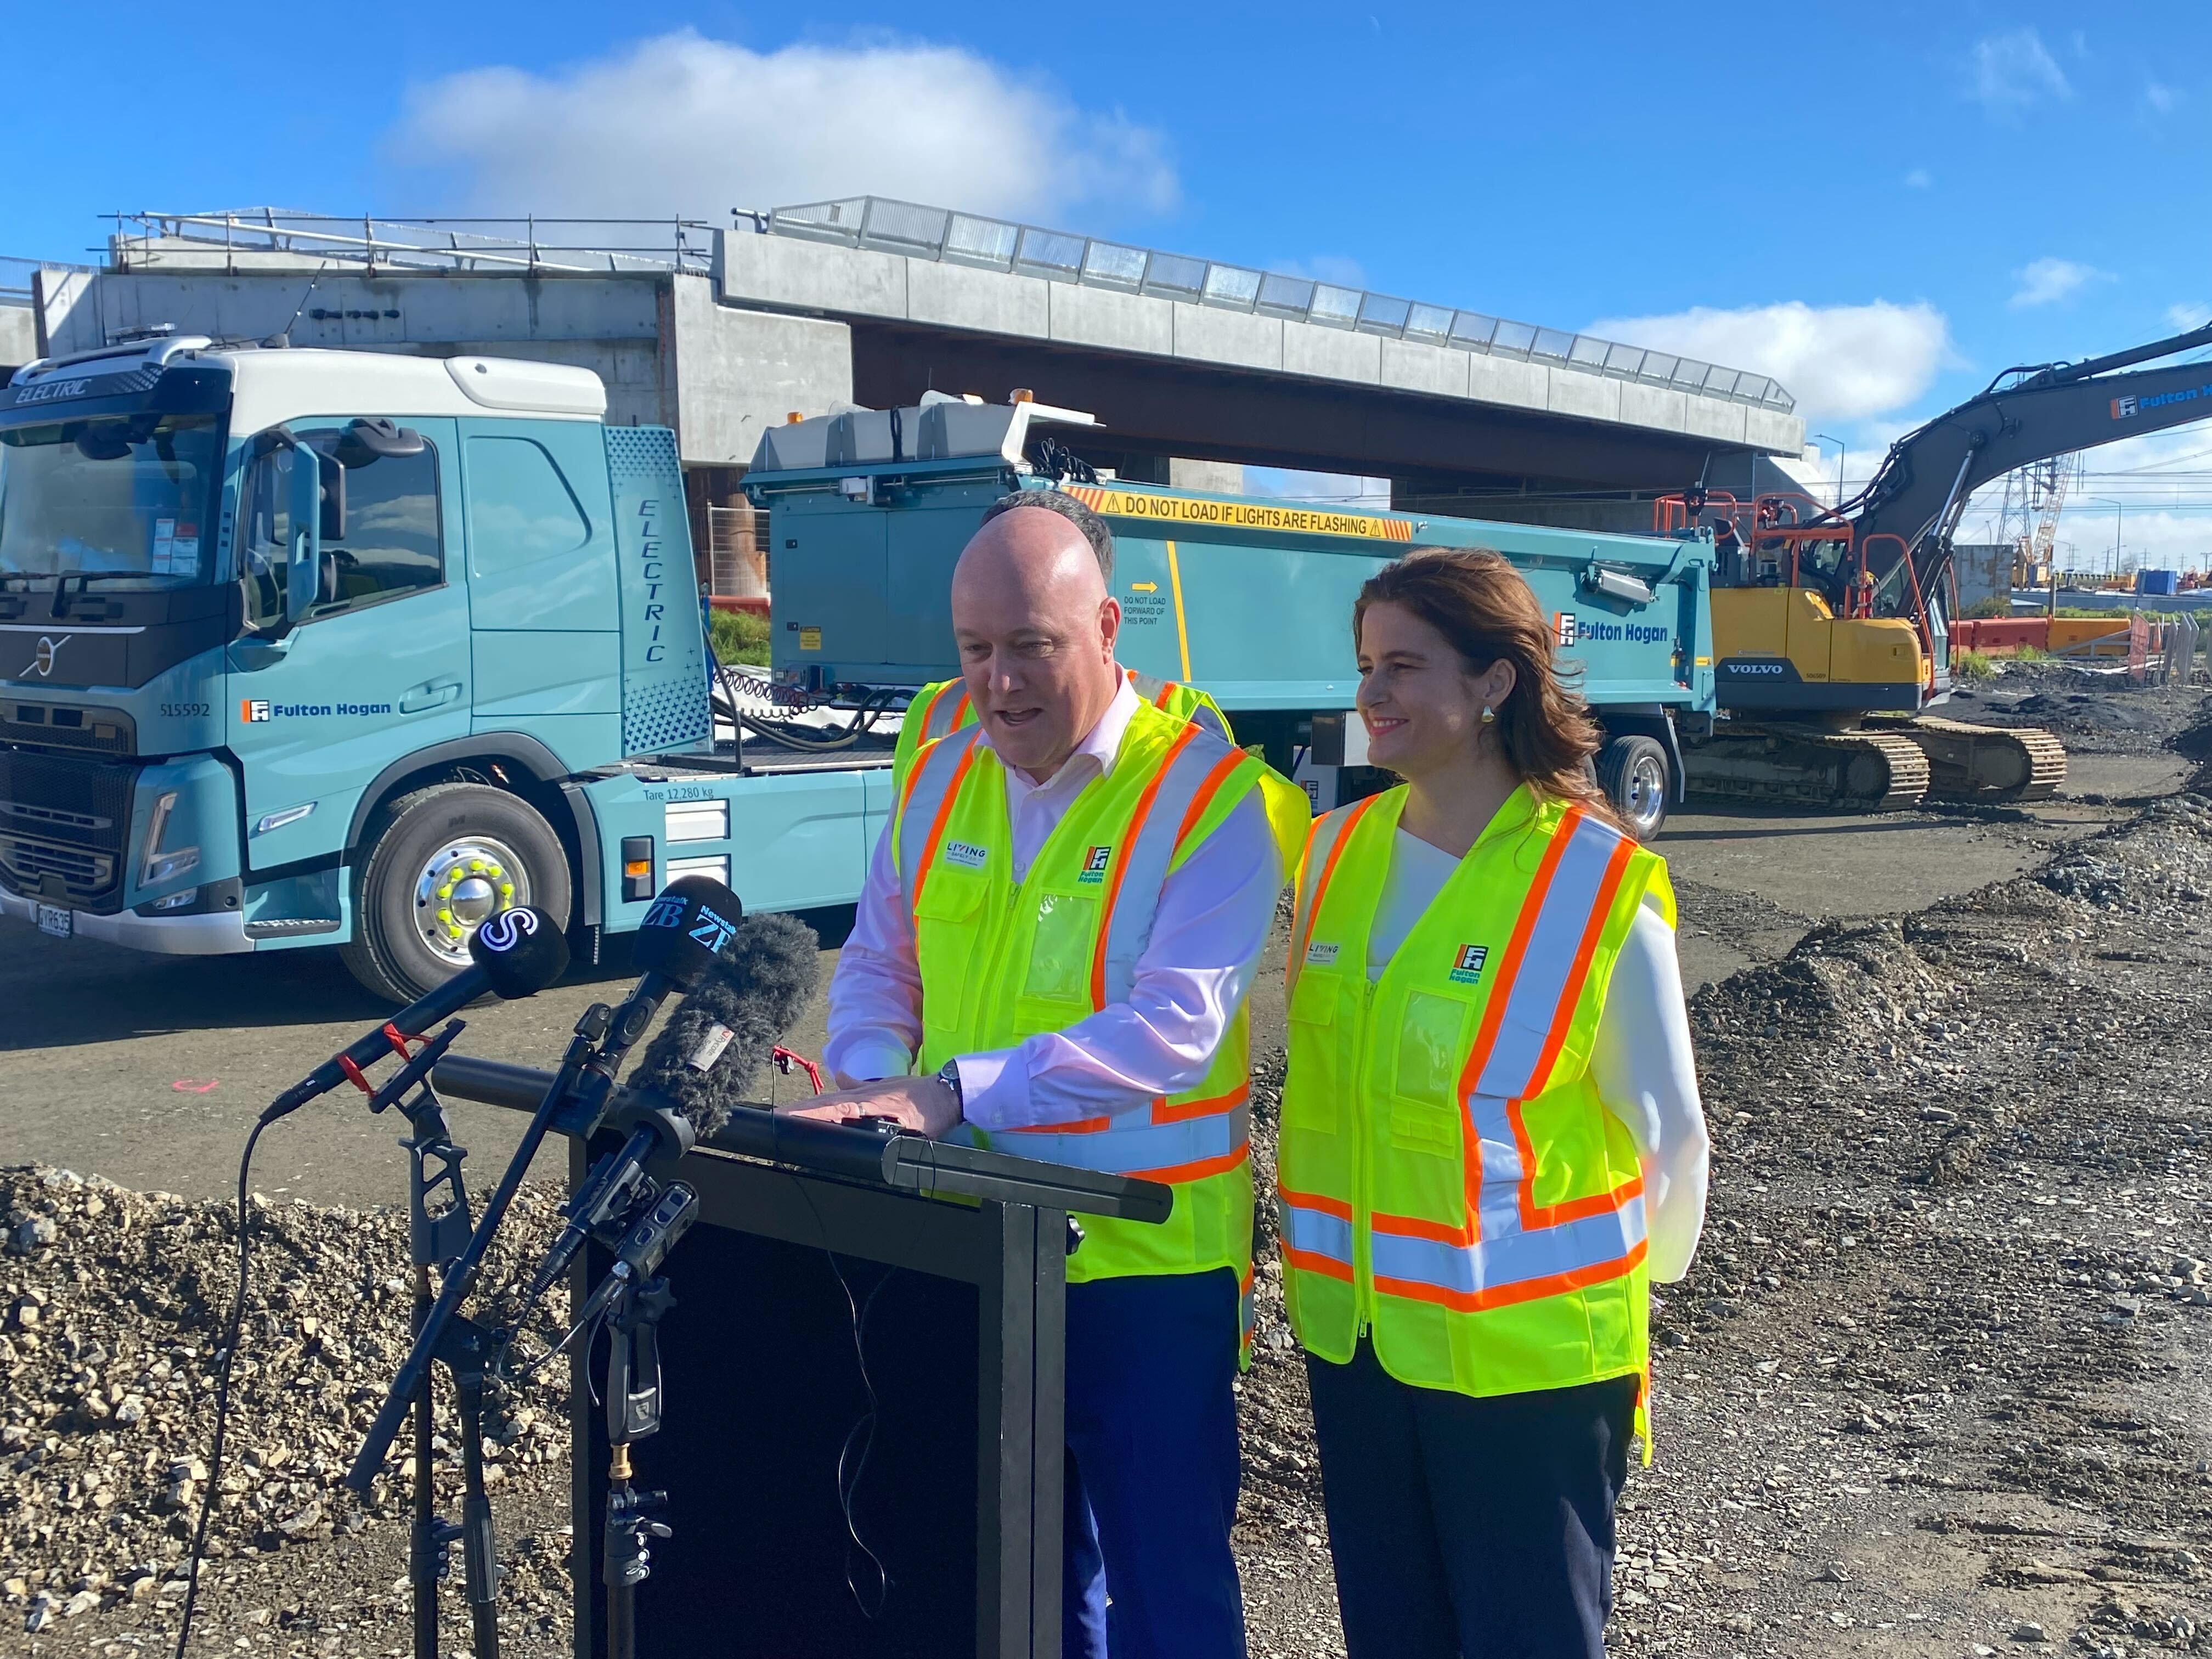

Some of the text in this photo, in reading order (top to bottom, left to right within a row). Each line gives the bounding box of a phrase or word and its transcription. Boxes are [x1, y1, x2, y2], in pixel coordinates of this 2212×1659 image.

[15, 379, 92, 403] ELECTRIC
[2140, 388, 2198, 409] Fulton
[1126, 496, 1366, 534] DO NOT LOAD IF LIGHTS ARE FLASHING
[638, 499, 665, 662] ELECTRIC
[1124, 606, 1155, 614] FORWARD
[1578, 622, 1668, 644] Fulton Hogan
[1728, 665, 1782, 674] VOLVO
[161, 703, 210, 716] 515592
[274, 703, 390, 716] Fulton Hogan
[643, 786, 714, 800] Tare 12,280 kg
[947, 842, 985, 857] LIVING
[1309, 944, 1339, 953] LIVING
[1449, 976, 1479, 984] Hogan
[1451, 969, 1480, 978] Fulton
[706, 1036, 725, 1056] Rycote
